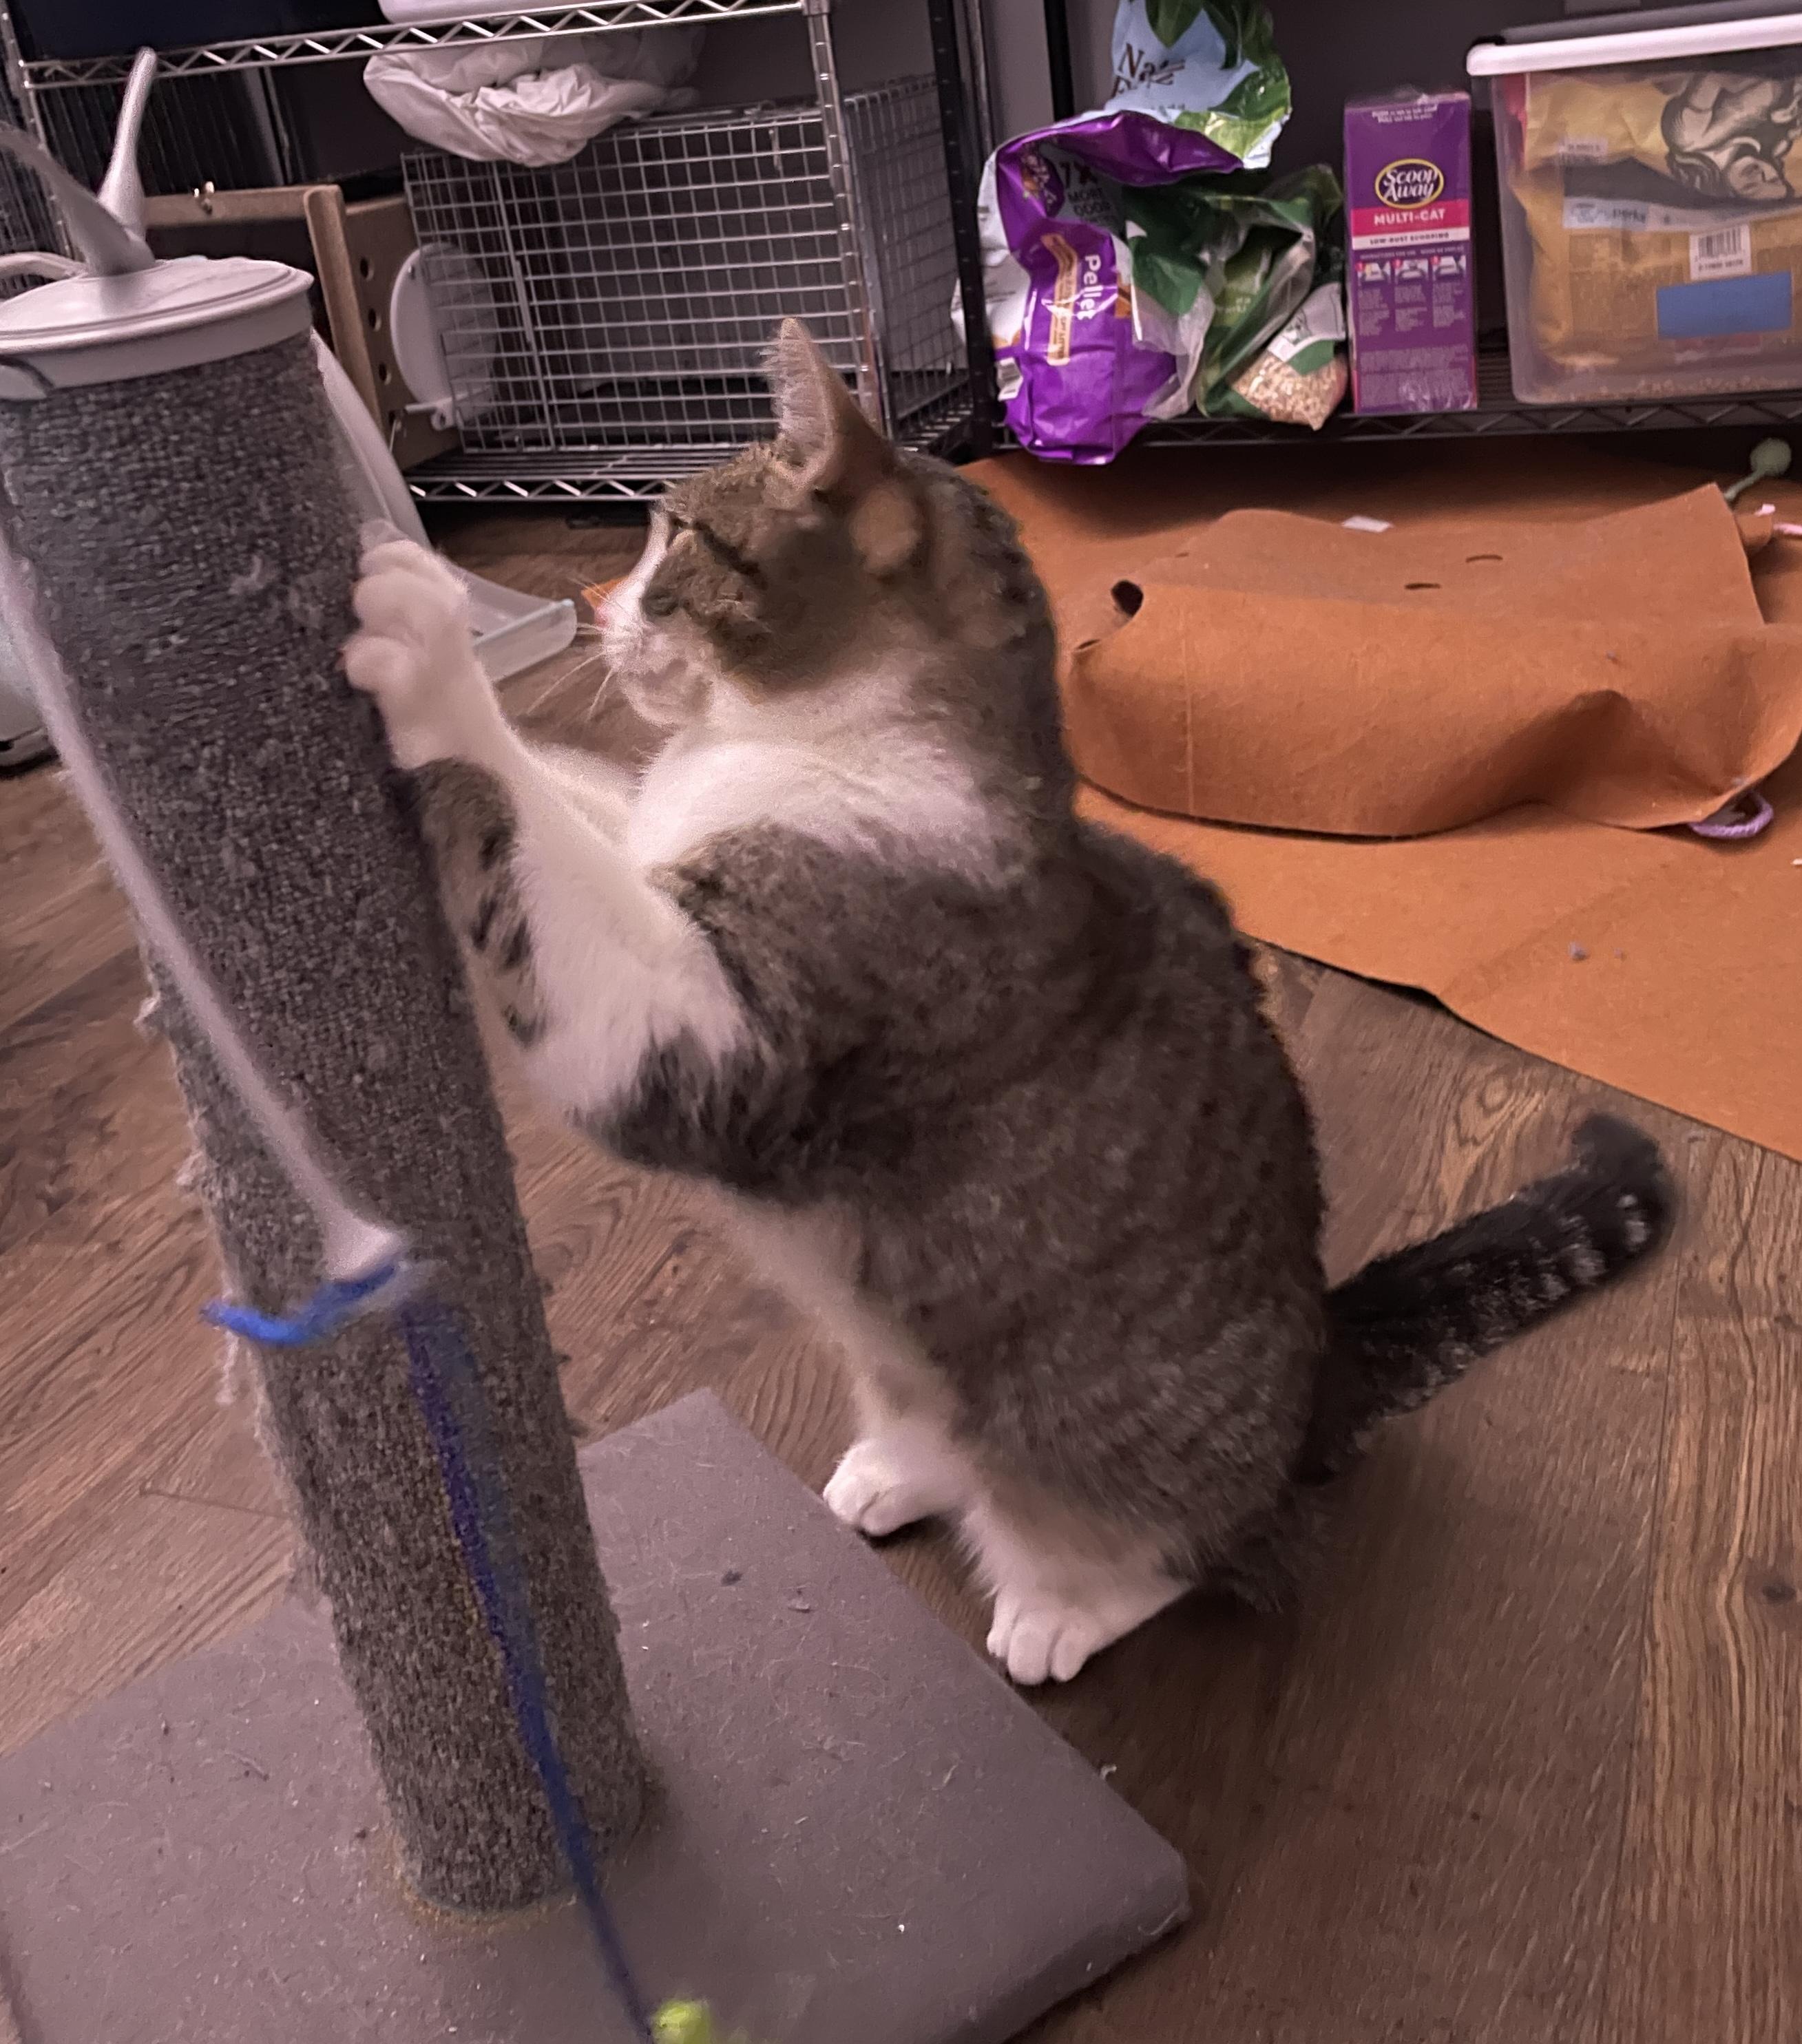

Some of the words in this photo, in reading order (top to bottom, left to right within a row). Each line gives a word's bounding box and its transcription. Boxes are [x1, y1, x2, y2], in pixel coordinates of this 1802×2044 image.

[1386, 169, 1438, 185] Scoop
[1383, 180, 1434, 202] Away
[1374, 208, 1445, 226] MULTI-CAT
[1076, 254, 1104, 320] Pellet
